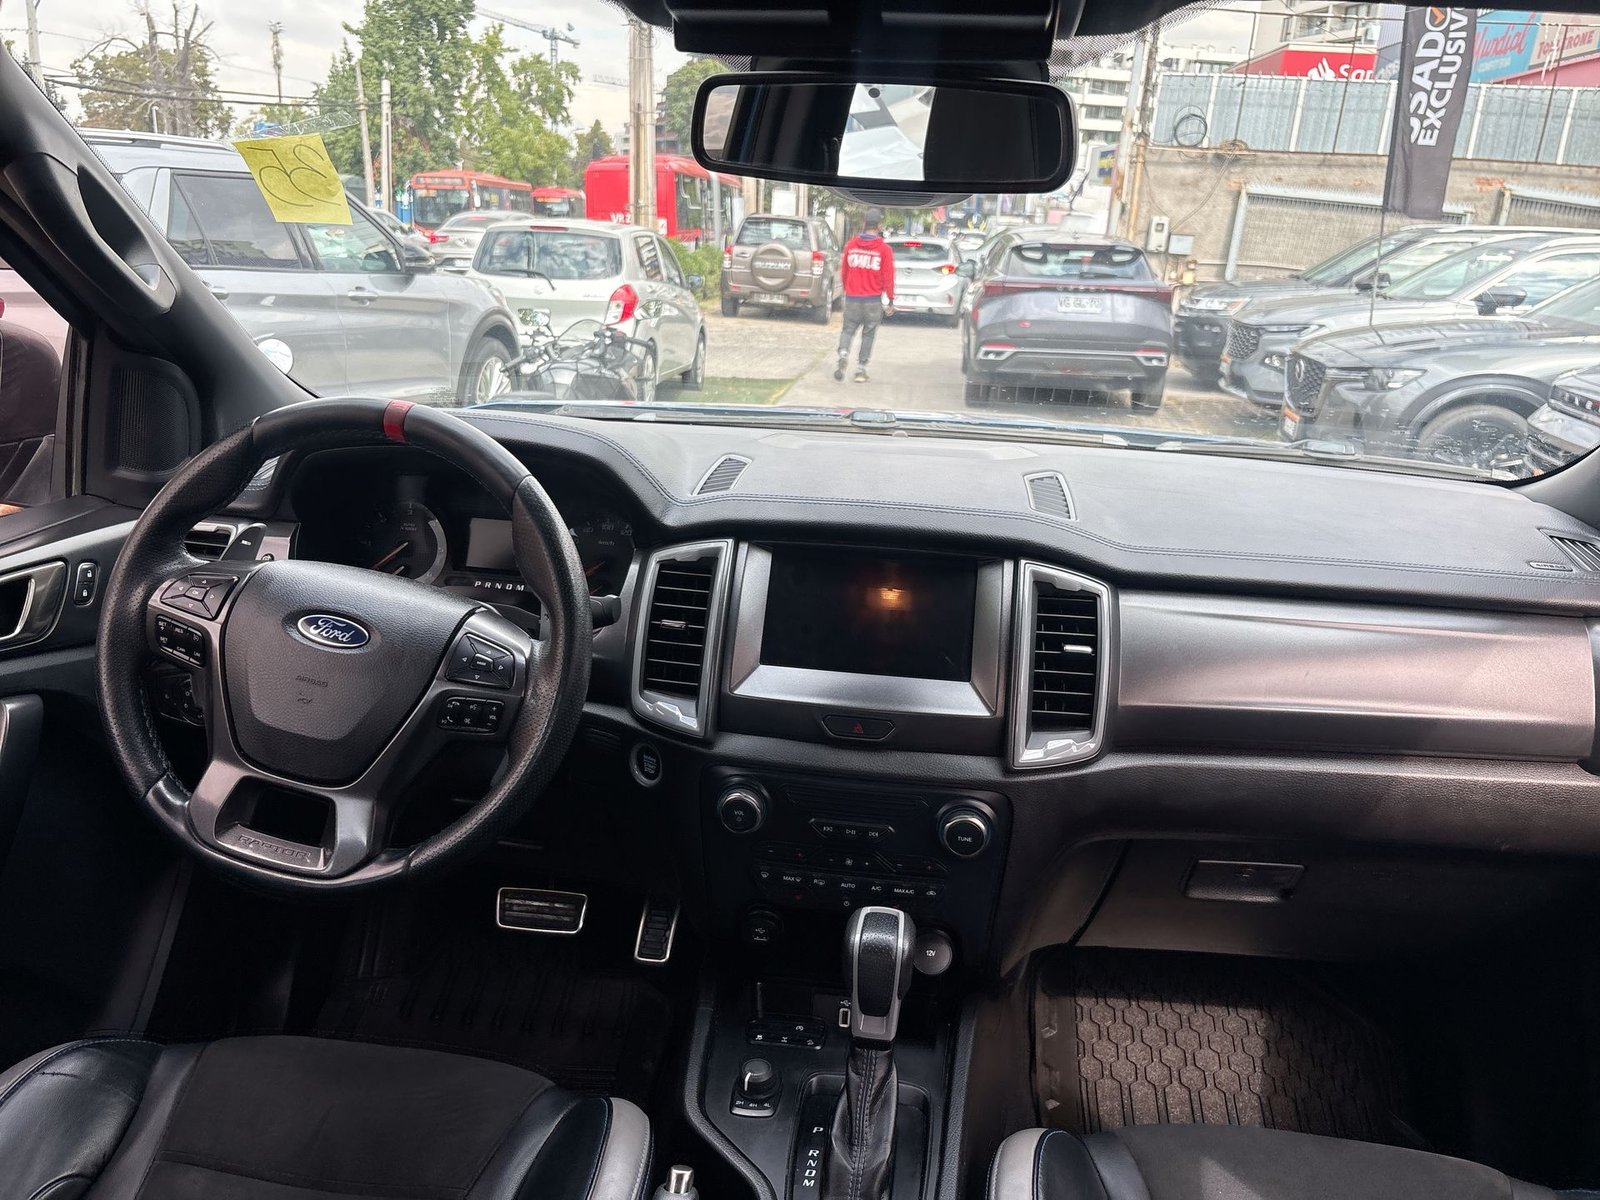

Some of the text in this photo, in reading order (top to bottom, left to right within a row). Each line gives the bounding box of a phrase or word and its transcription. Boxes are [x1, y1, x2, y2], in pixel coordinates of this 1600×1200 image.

[1417, 7, 1469, 146] EXCLUSIV
[474, 580, 482, 588] P
[484, 581, 492, 589] R
[309, 617, 356, 642] Ford
[295, 674, 328, 688] AIRBAG
[239, 834, 312, 862] RAPTOR
[808, 1149, 820, 1157] R
[806, 1159, 818, 1167] N
[804, 1169, 816, 1177] D
[803, 1179, 815, 1187] M
